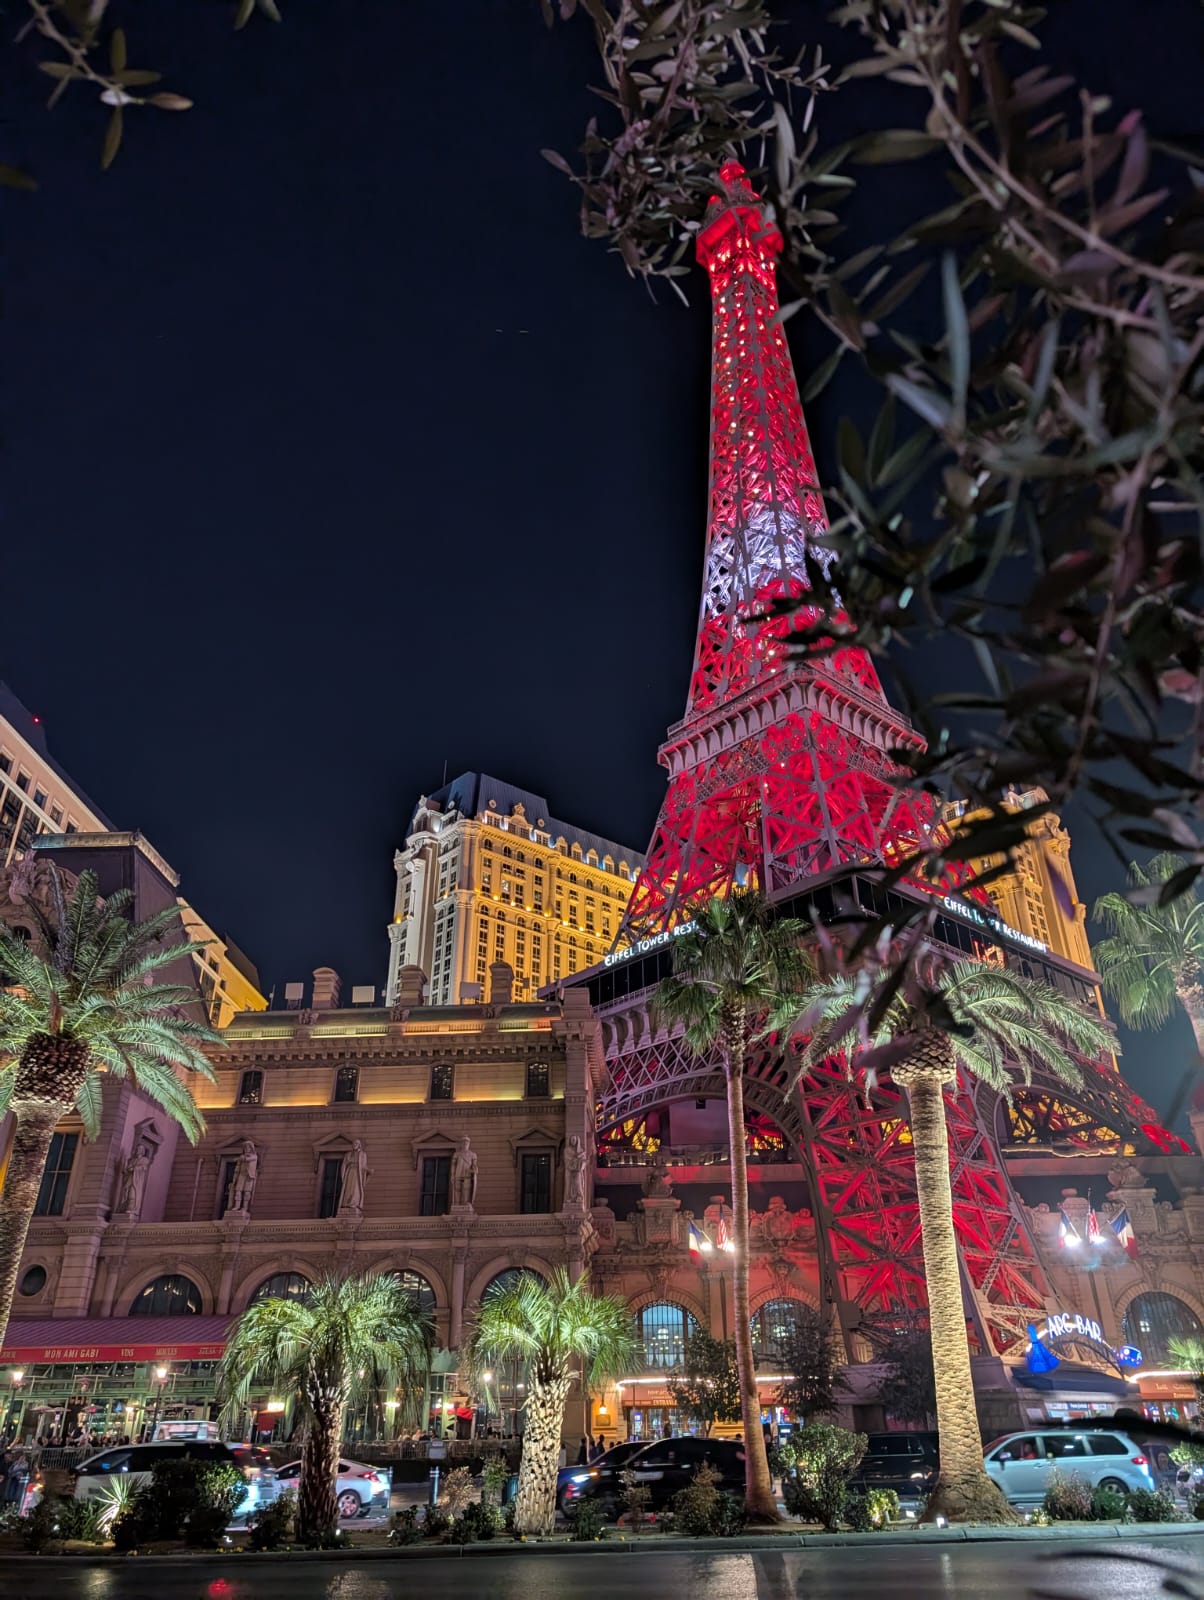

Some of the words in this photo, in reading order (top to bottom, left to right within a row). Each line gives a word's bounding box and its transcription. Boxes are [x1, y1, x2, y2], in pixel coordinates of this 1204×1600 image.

[943, 896, 973, 919] EIFFEL
[972, 908, 1000, 932] TOR
[1002, 923, 1047, 953] RESTAURANT
[604, 947, 634, 967] EIFFEL
[637, 932, 669, 953] TOWER
[1047, 1312, 1073, 1339] ARC
[1075, 1314, 1102, 1343] BAR
[44, 1349, 62, 1359] MON
[63, 1349, 78, 1359] AMI
[80, 1348, 99, 1358] GABI
